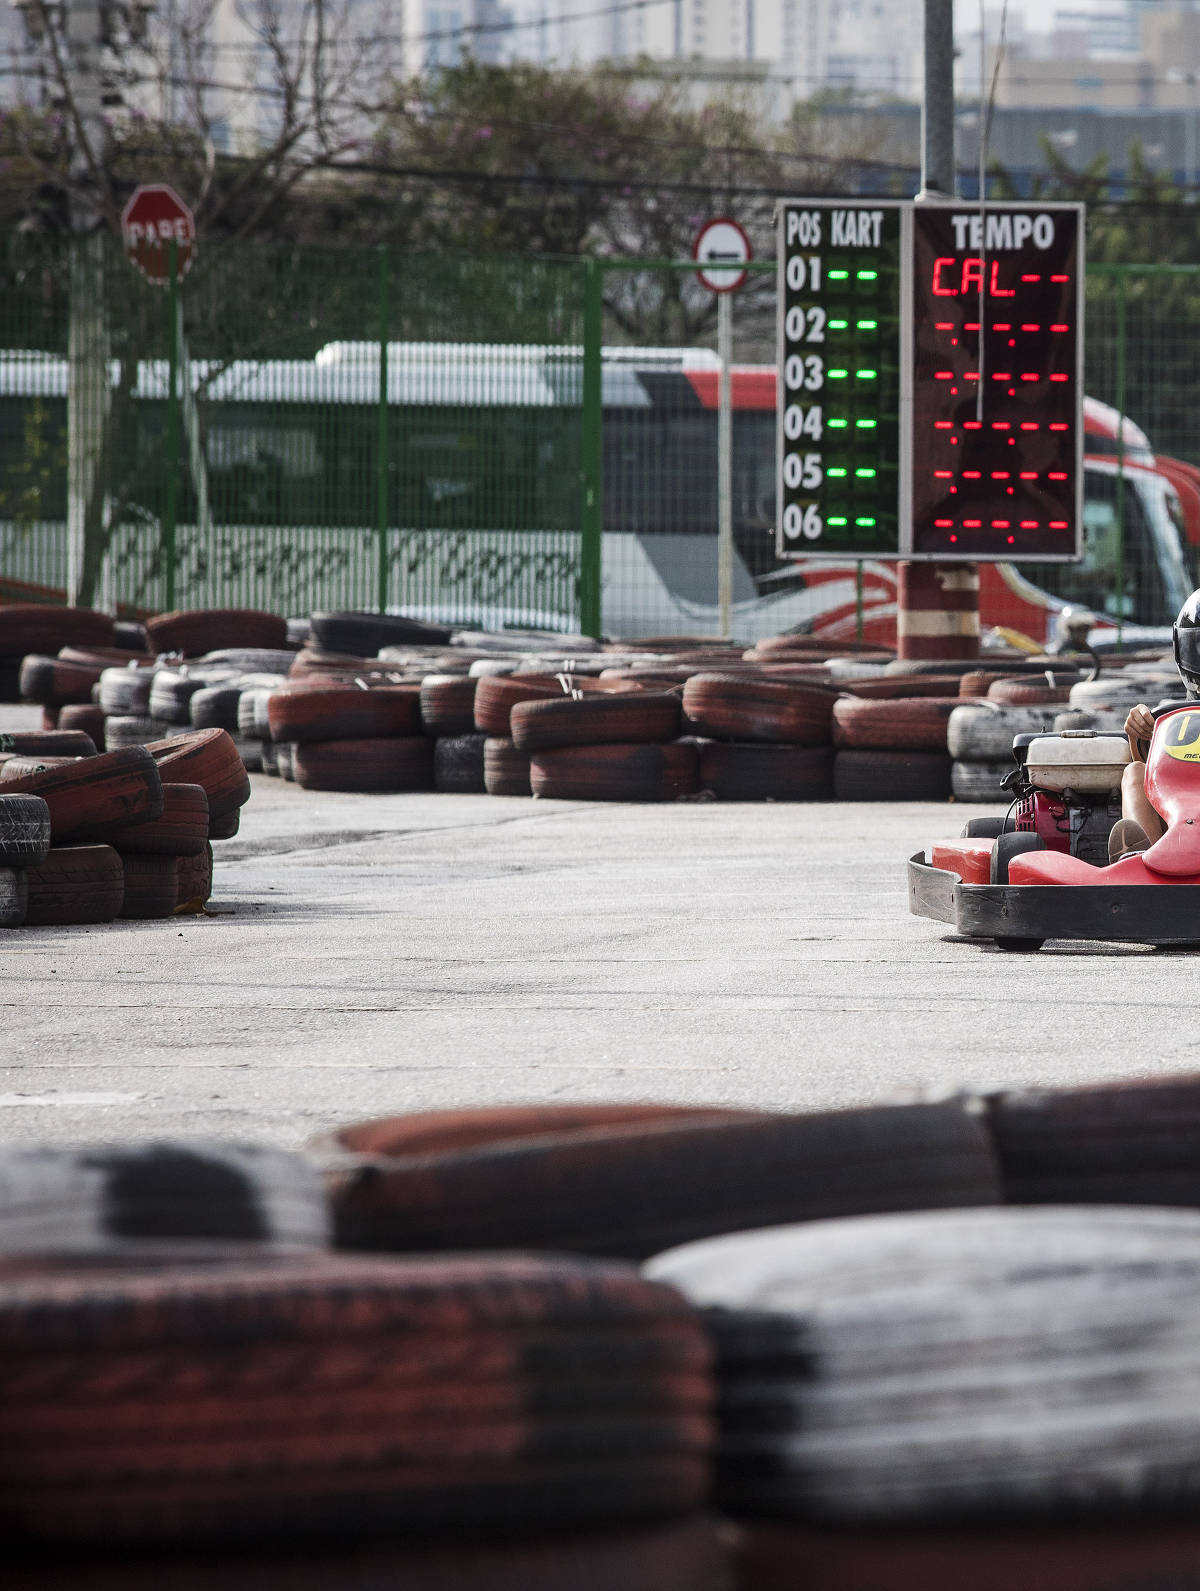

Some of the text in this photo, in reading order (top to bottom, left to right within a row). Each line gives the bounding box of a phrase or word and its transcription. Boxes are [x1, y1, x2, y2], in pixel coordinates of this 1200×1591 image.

[787, 211, 883, 247] POS KART
[952, 214, 1055, 250] TEMPO
[786, 256, 822, 291] 01
[785, 306, 826, 342] 02
[785, 355, 824, 391] 03
[783, 404, 823, 441] 04
[783, 453, 822, 489] 05
[783, 503, 822, 539] 06
